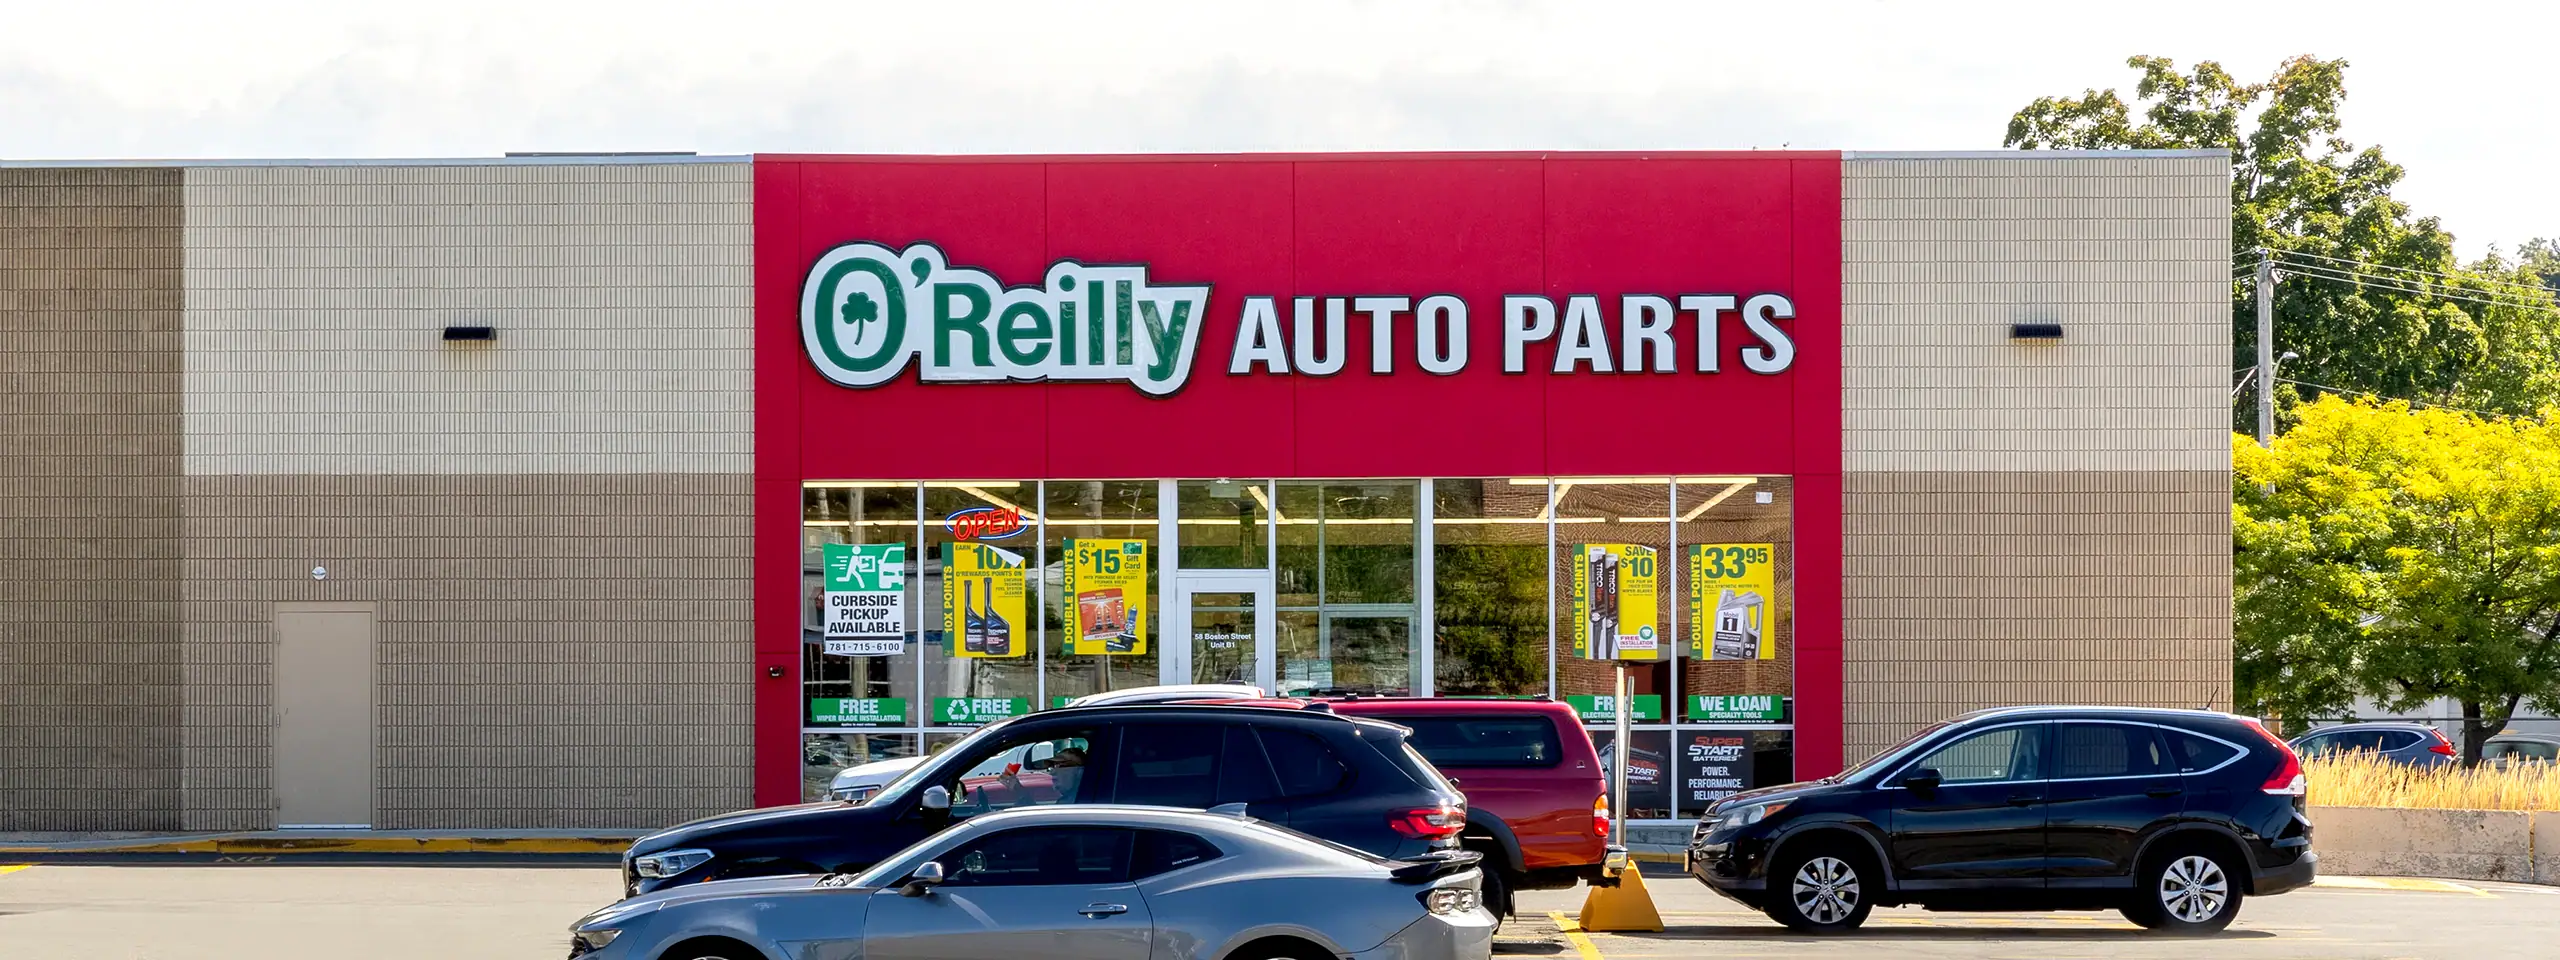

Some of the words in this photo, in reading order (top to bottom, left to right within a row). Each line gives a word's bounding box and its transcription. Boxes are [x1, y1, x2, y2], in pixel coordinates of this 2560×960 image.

[814, 255, 1194, 383] O'Reilly
[1227, 294, 1471, 376] AUTO
[1501, 293, 1797, 375] PARTS
[954, 506, 1021, 541] OPEN
[1625, 546, 1652, 557] SAVE
[1079, 548, 1121, 574] $15
[1620, 557, 1653, 578] $10
[1064, 549, 1074, 592] POINTS
[1575, 554, 1584, 598] POINTS
[1690, 554, 1701, 598] POINTS
[943, 565, 953, 609] POINTS
[1608, 569, 1616, 594] TRICO
[831, 595, 898, 607] CURBSIDE
[840, 608, 889, 620] PICKUP
[1064, 595, 1073, 644] DOUBLE
[828, 622, 901, 633] AVAILABLE
[943, 612, 953, 634] 10X
[1575, 601, 1584, 649] DOUBLE
[1692, 601, 1701, 650] DOUBLE
[829, 643, 900, 651] 781-715-6100
[839, 698, 879, 714] FREE
[972, 698, 1012, 714] FREE
[1699, 695, 1725, 711] WE
[1729, 695, 1772, 711] LOAN
[1709, 711, 1741, 719] SPECIALTY
[1742, 711, 1762, 719] TOOLS
[1695, 736, 1744, 746] SUPER
[1687, 744, 1746, 756] START
[1627, 765, 1658, 776] START
[1702, 766, 1730, 776] POWER.
[1688, 778, 1744, 788] PERFORMANCE.
